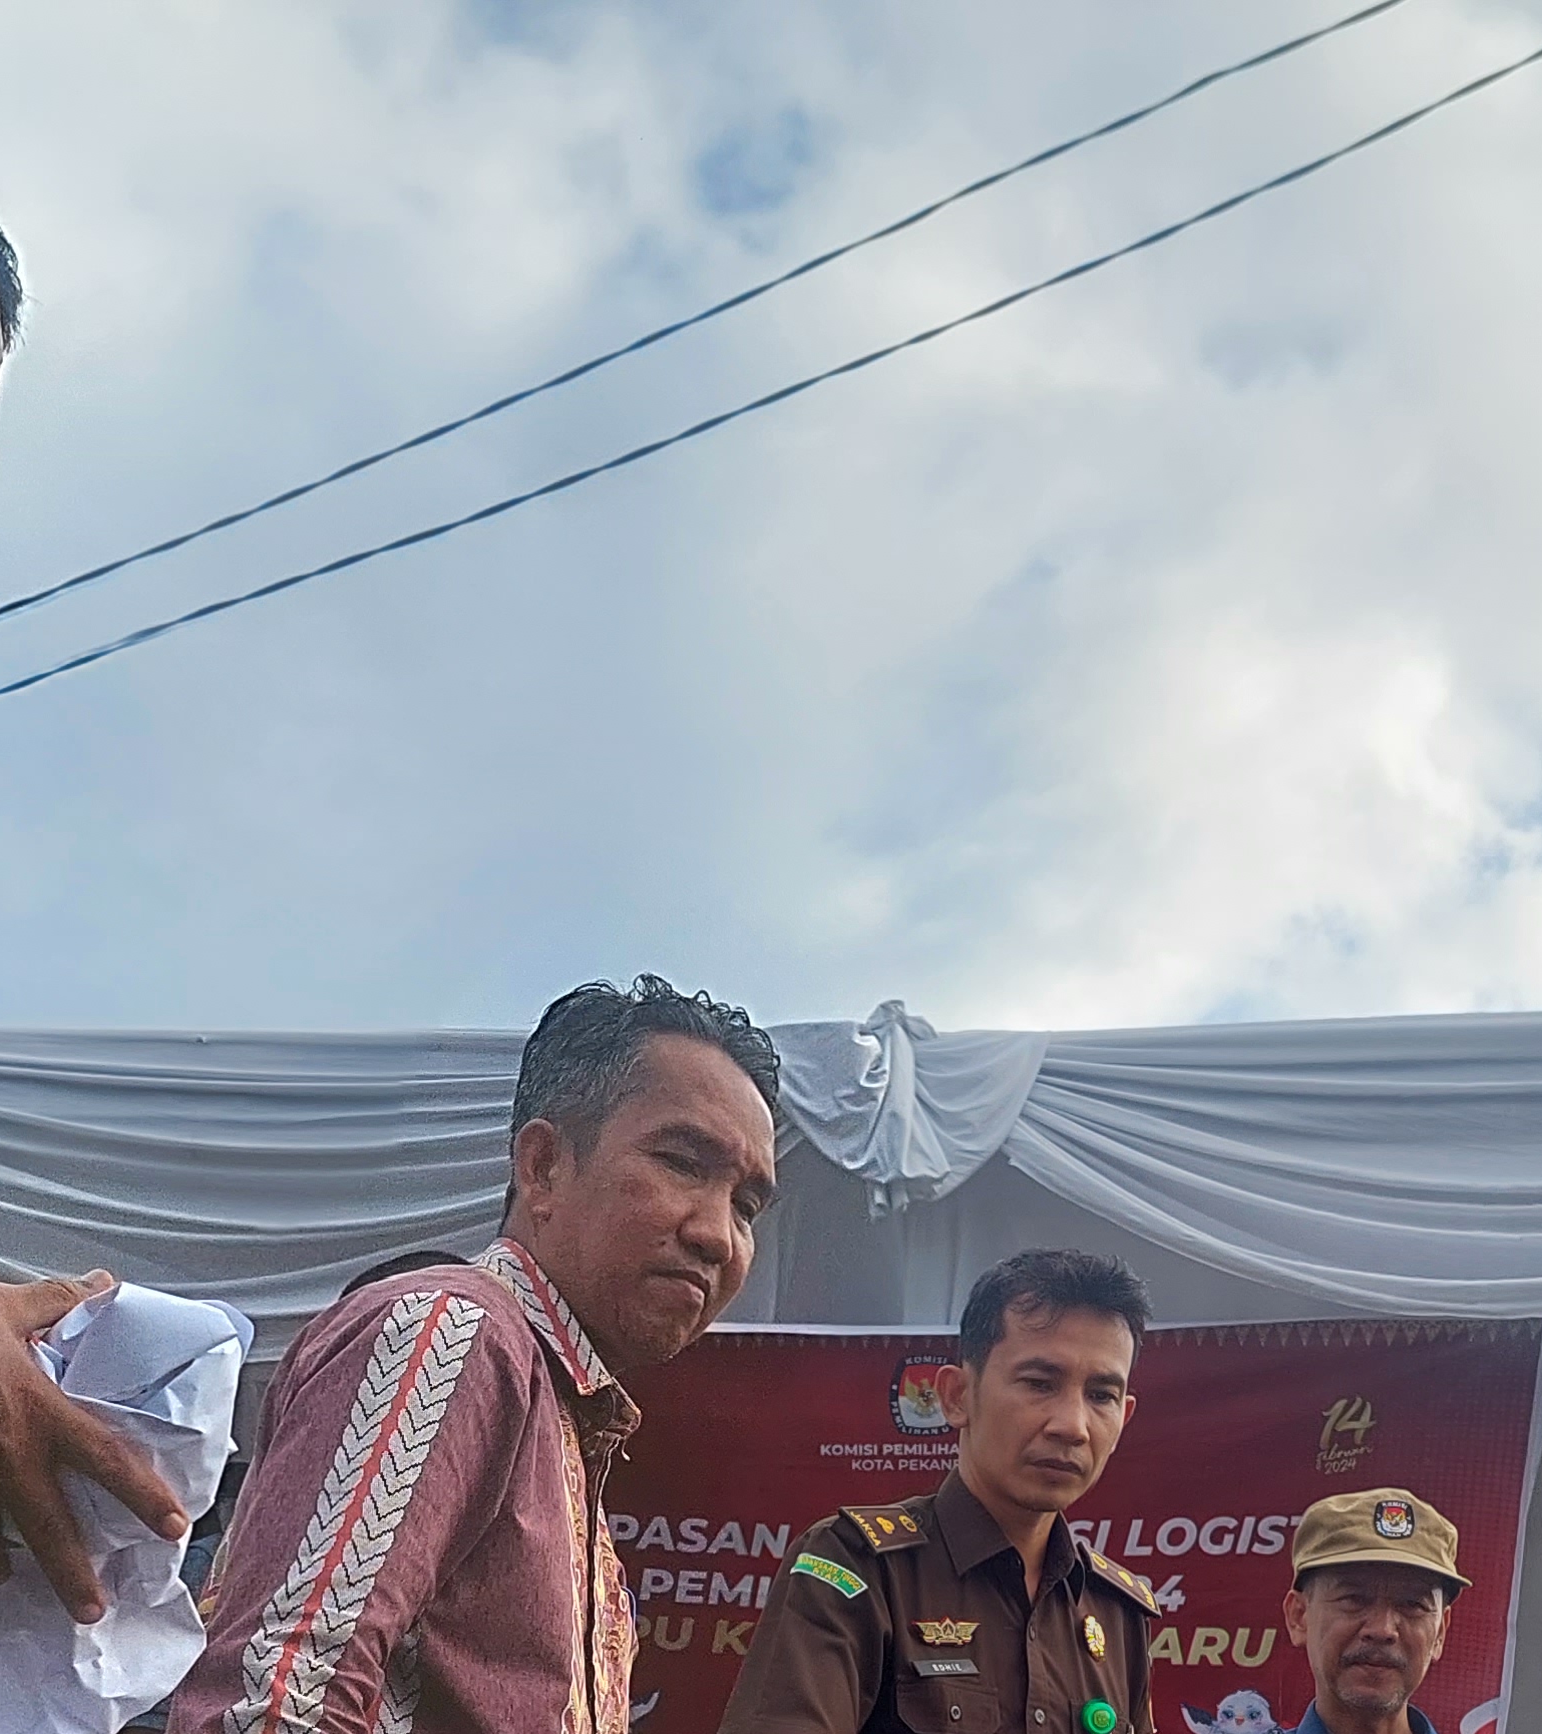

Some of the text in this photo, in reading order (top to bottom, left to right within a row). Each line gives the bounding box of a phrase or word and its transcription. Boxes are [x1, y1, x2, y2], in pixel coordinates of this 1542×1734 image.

[1321, 1397, 1376, 1449] 14
[820, 1443, 879, 1456] KOMISI
[851, 1459, 895, 1472] KOTA
[1325, 1459, 1357, 1475] 2024
[850, 1511, 881, 1546] JAKSA
[1123, 1515, 1303, 1557] LOGIS
